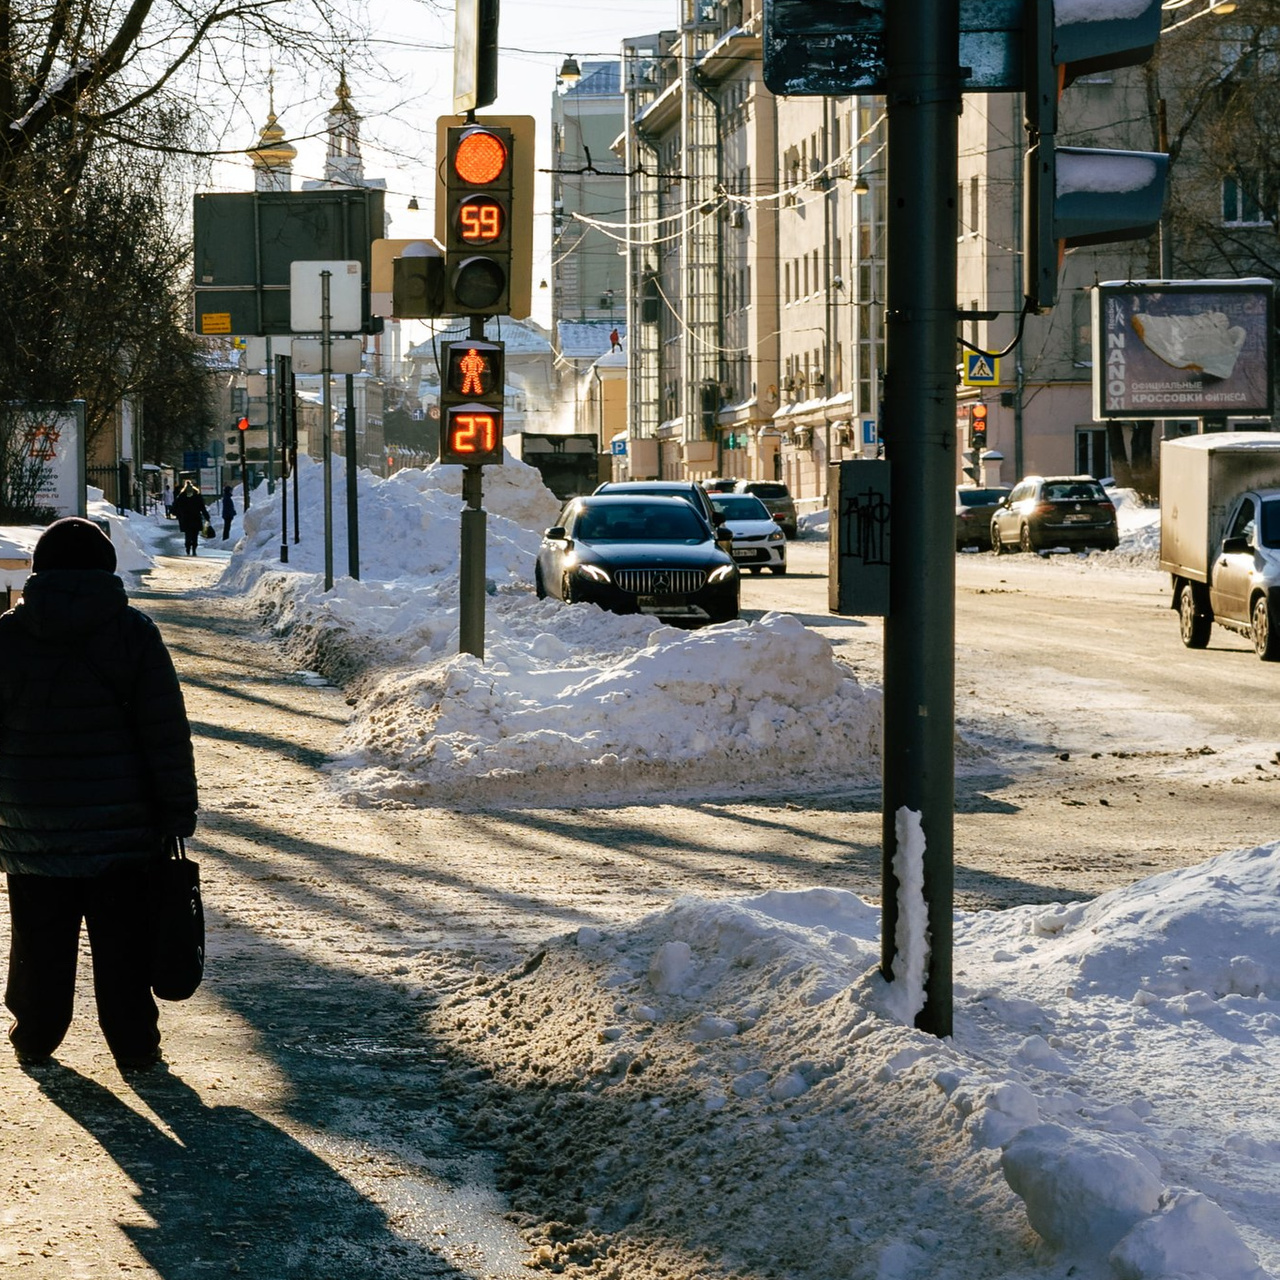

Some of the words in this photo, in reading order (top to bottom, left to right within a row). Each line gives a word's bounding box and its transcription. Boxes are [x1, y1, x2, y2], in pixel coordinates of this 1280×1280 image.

[461, 205, 499, 238] 59
[1108, 333, 1126, 396] NANO
[1131, 381, 1203, 390] ОФИЦИАЛЬНЫЕ
[1131, 393, 1203, 403] КРОССОВКИ
[1205, 392, 1247, 402] ФИТНЕСА
[455, 416, 494, 451] 27
[615, 442, 624, 454] P
